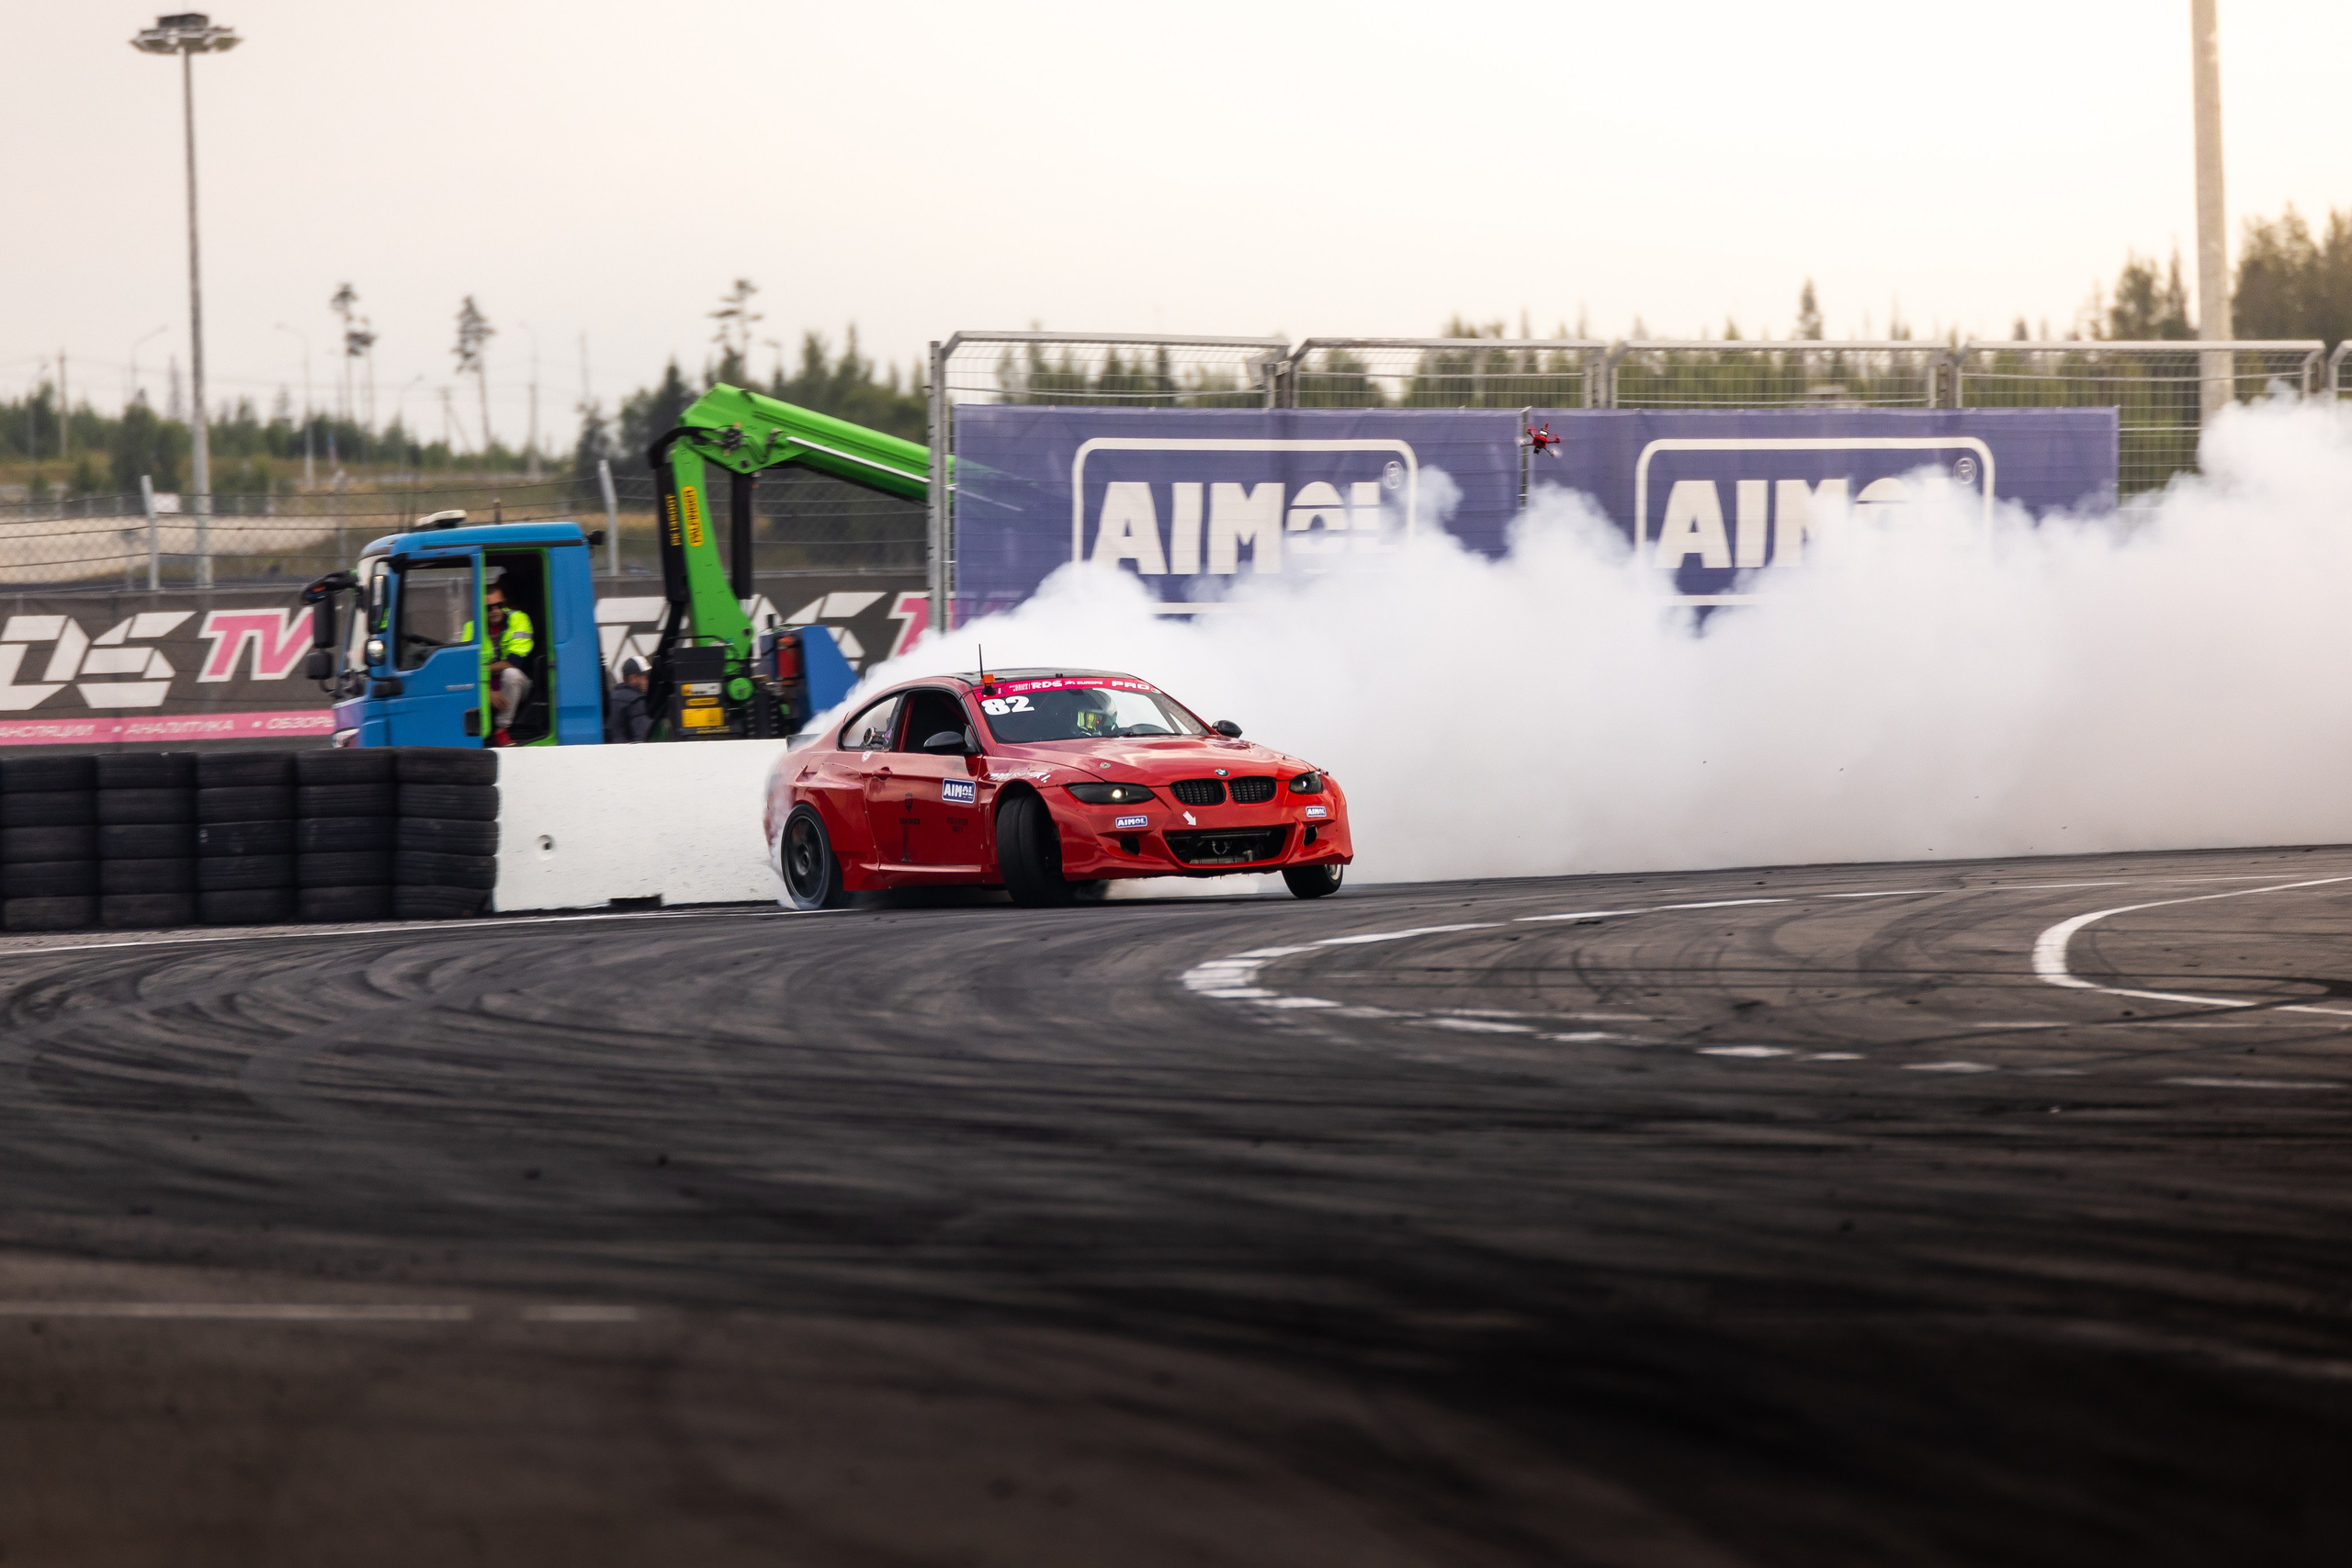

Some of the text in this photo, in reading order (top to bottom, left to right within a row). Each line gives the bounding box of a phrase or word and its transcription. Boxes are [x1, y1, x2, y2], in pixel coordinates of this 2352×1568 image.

[683, 489, 702, 544] PALFINGER
[1112, 681, 1150, 690] PRO
[981, 695, 1035, 716] 82
[944, 784, 974, 798] AIMOL
